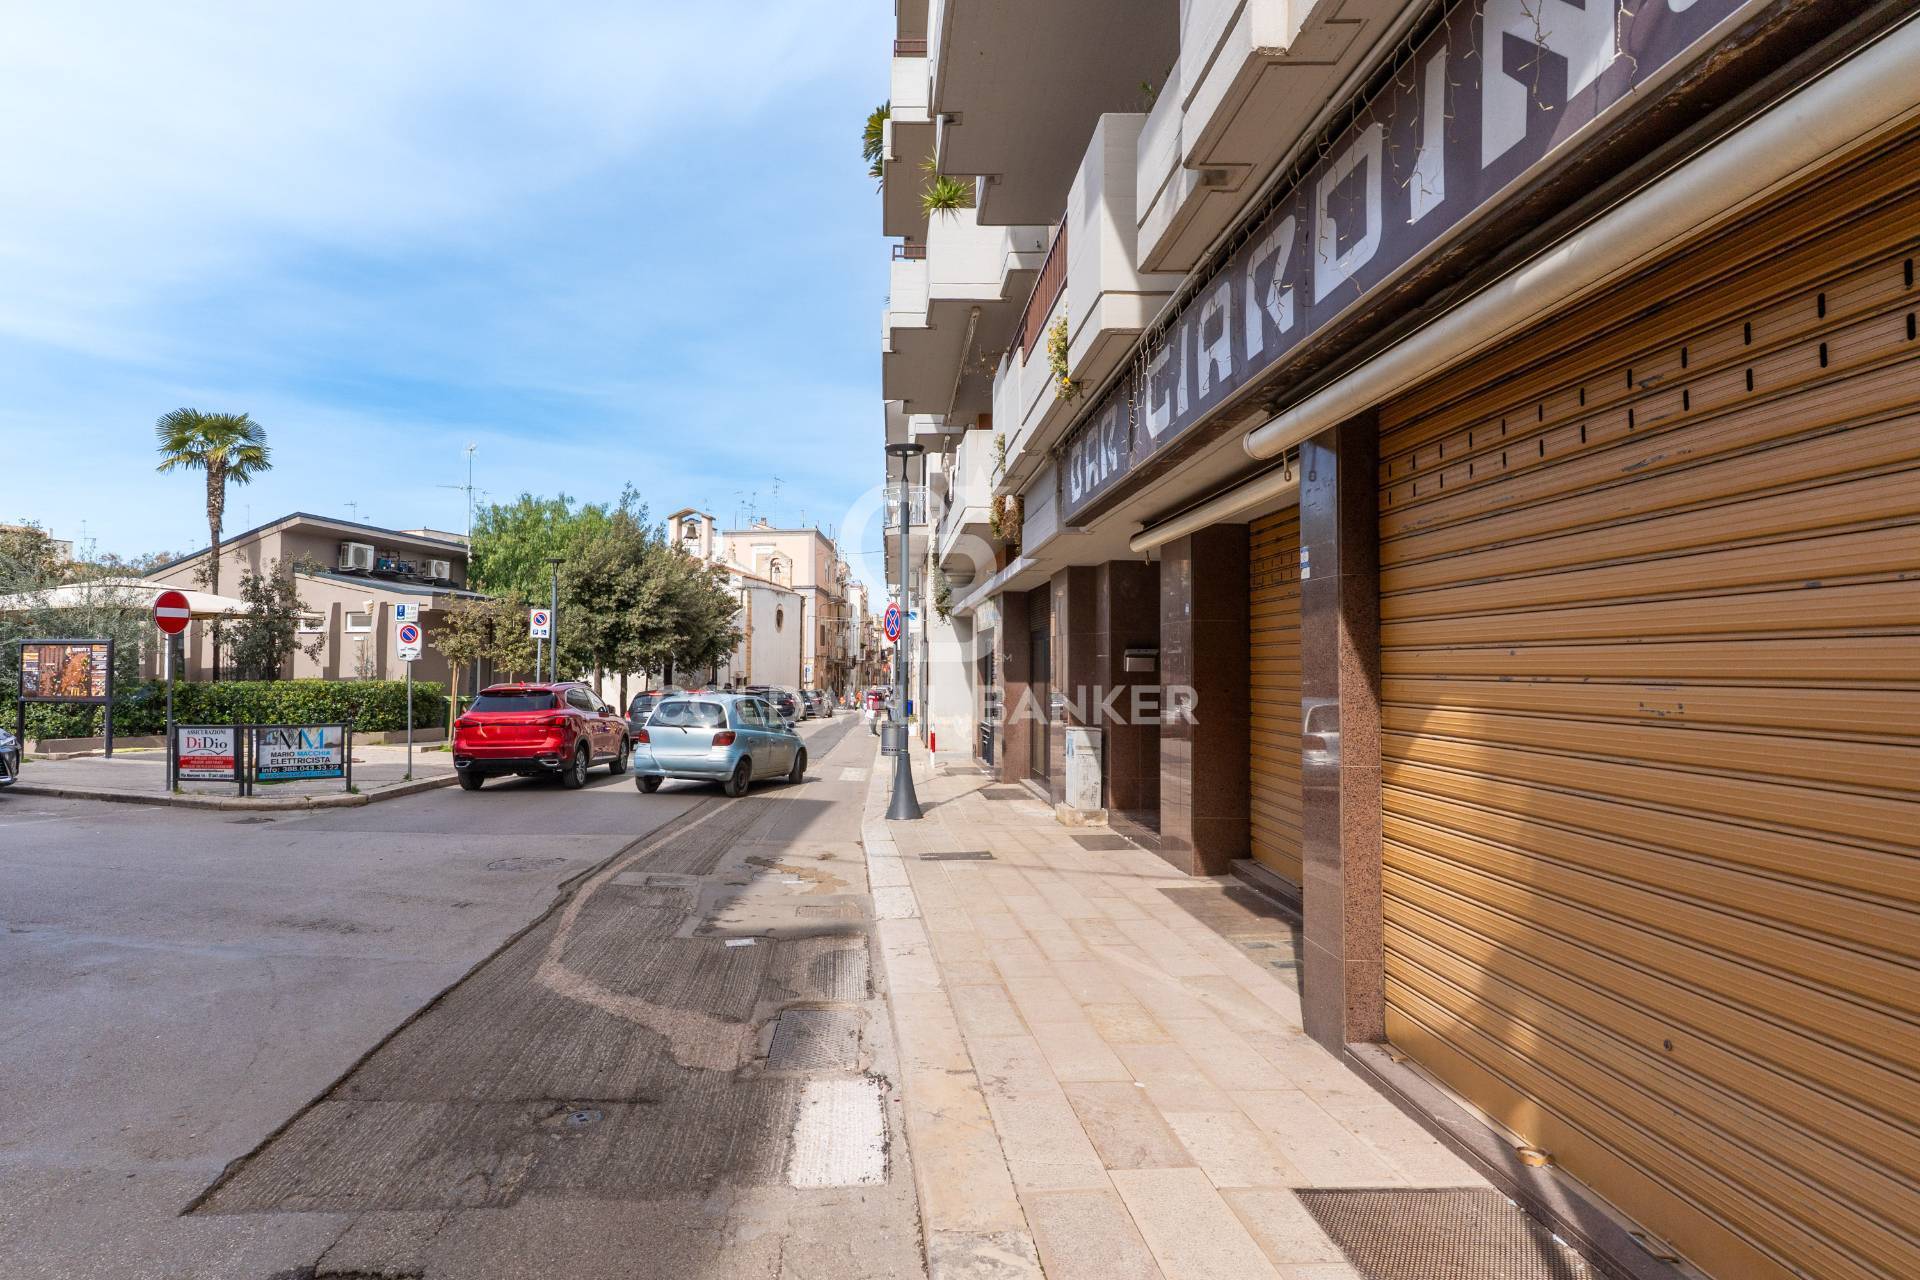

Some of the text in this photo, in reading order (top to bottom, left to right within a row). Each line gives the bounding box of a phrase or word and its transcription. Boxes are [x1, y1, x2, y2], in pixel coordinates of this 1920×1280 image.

[1070, 0, 1700, 504] BAR GIARDIN
[186, 736, 228, 749] DiDio
[279, 727, 325, 750] MM
[270, 756, 332, 765] ELETTRICISTA
